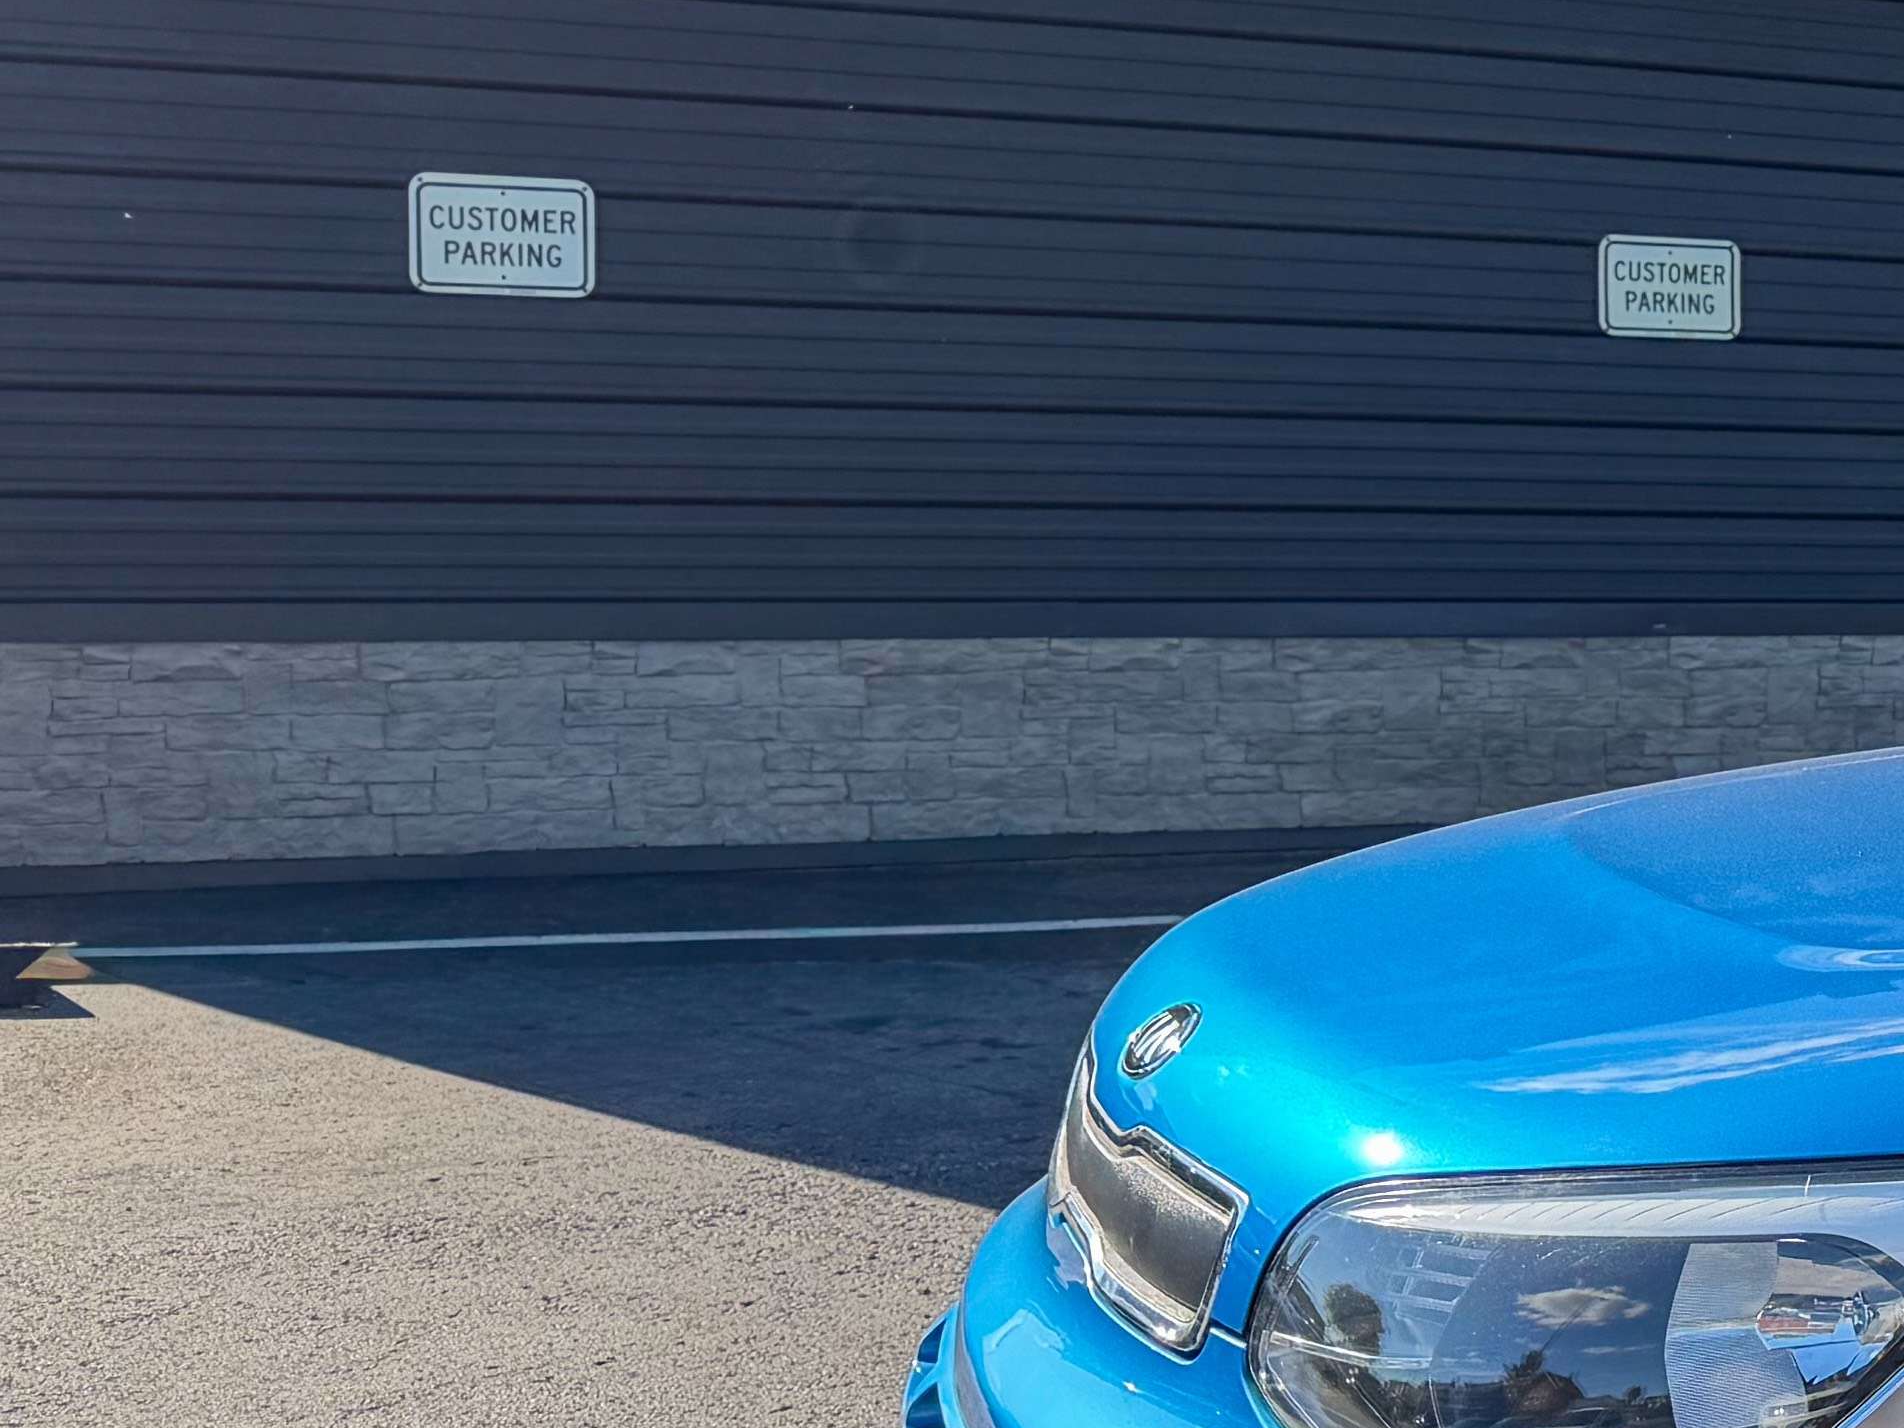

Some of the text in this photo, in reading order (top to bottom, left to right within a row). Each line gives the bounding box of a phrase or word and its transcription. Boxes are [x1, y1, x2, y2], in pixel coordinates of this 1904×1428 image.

[429, 205, 576, 235] CUSTOMER
[443, 240, 562, 268] PARKING
[1614, 260, 1725, 285] CUSTOMER
[1625, 290, 1715, 315] PARKING
